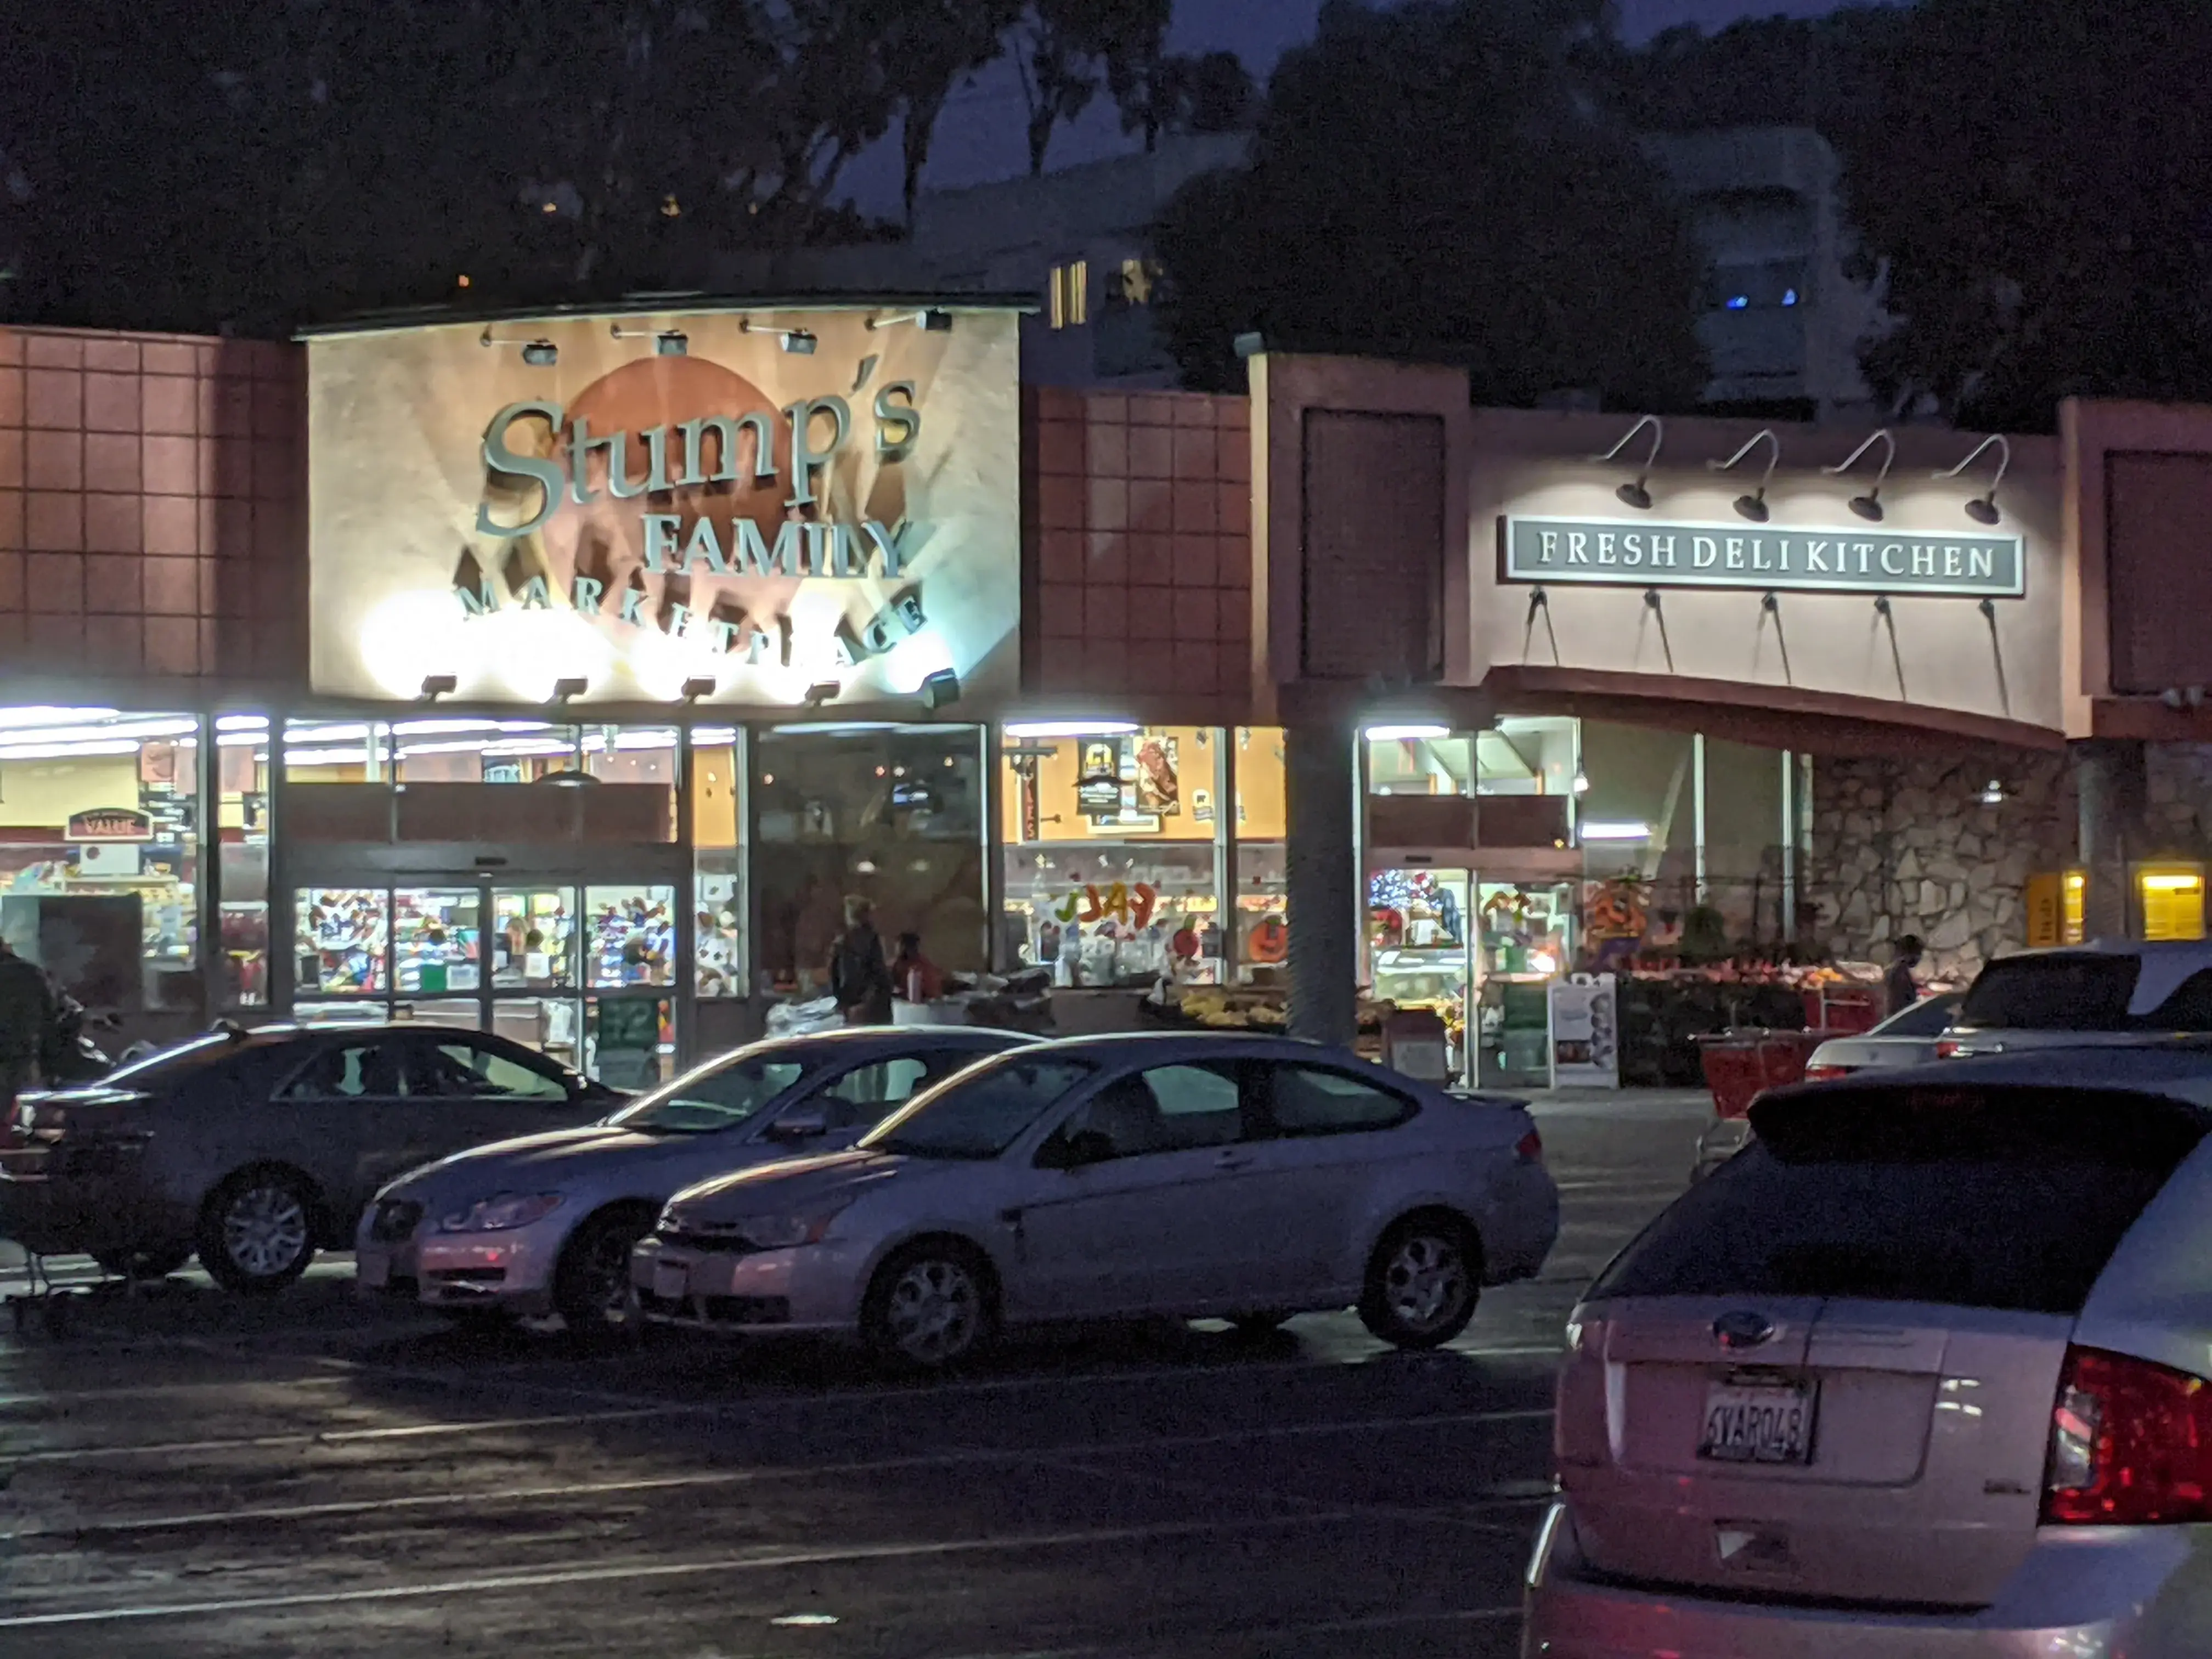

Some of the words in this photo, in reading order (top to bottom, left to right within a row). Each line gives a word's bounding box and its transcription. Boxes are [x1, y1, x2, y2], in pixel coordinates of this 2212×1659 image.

[475, 354, 921, 537] Stump's
[642, 514, 911, 578] FAMILY
[1538, 531, 1677, 567] FRESH
[1692, 536, 1790, 572] DELI
[1806, 540, 1993, 578] KITCHEN
[453, 576, 928, 667] MARKETPACE
